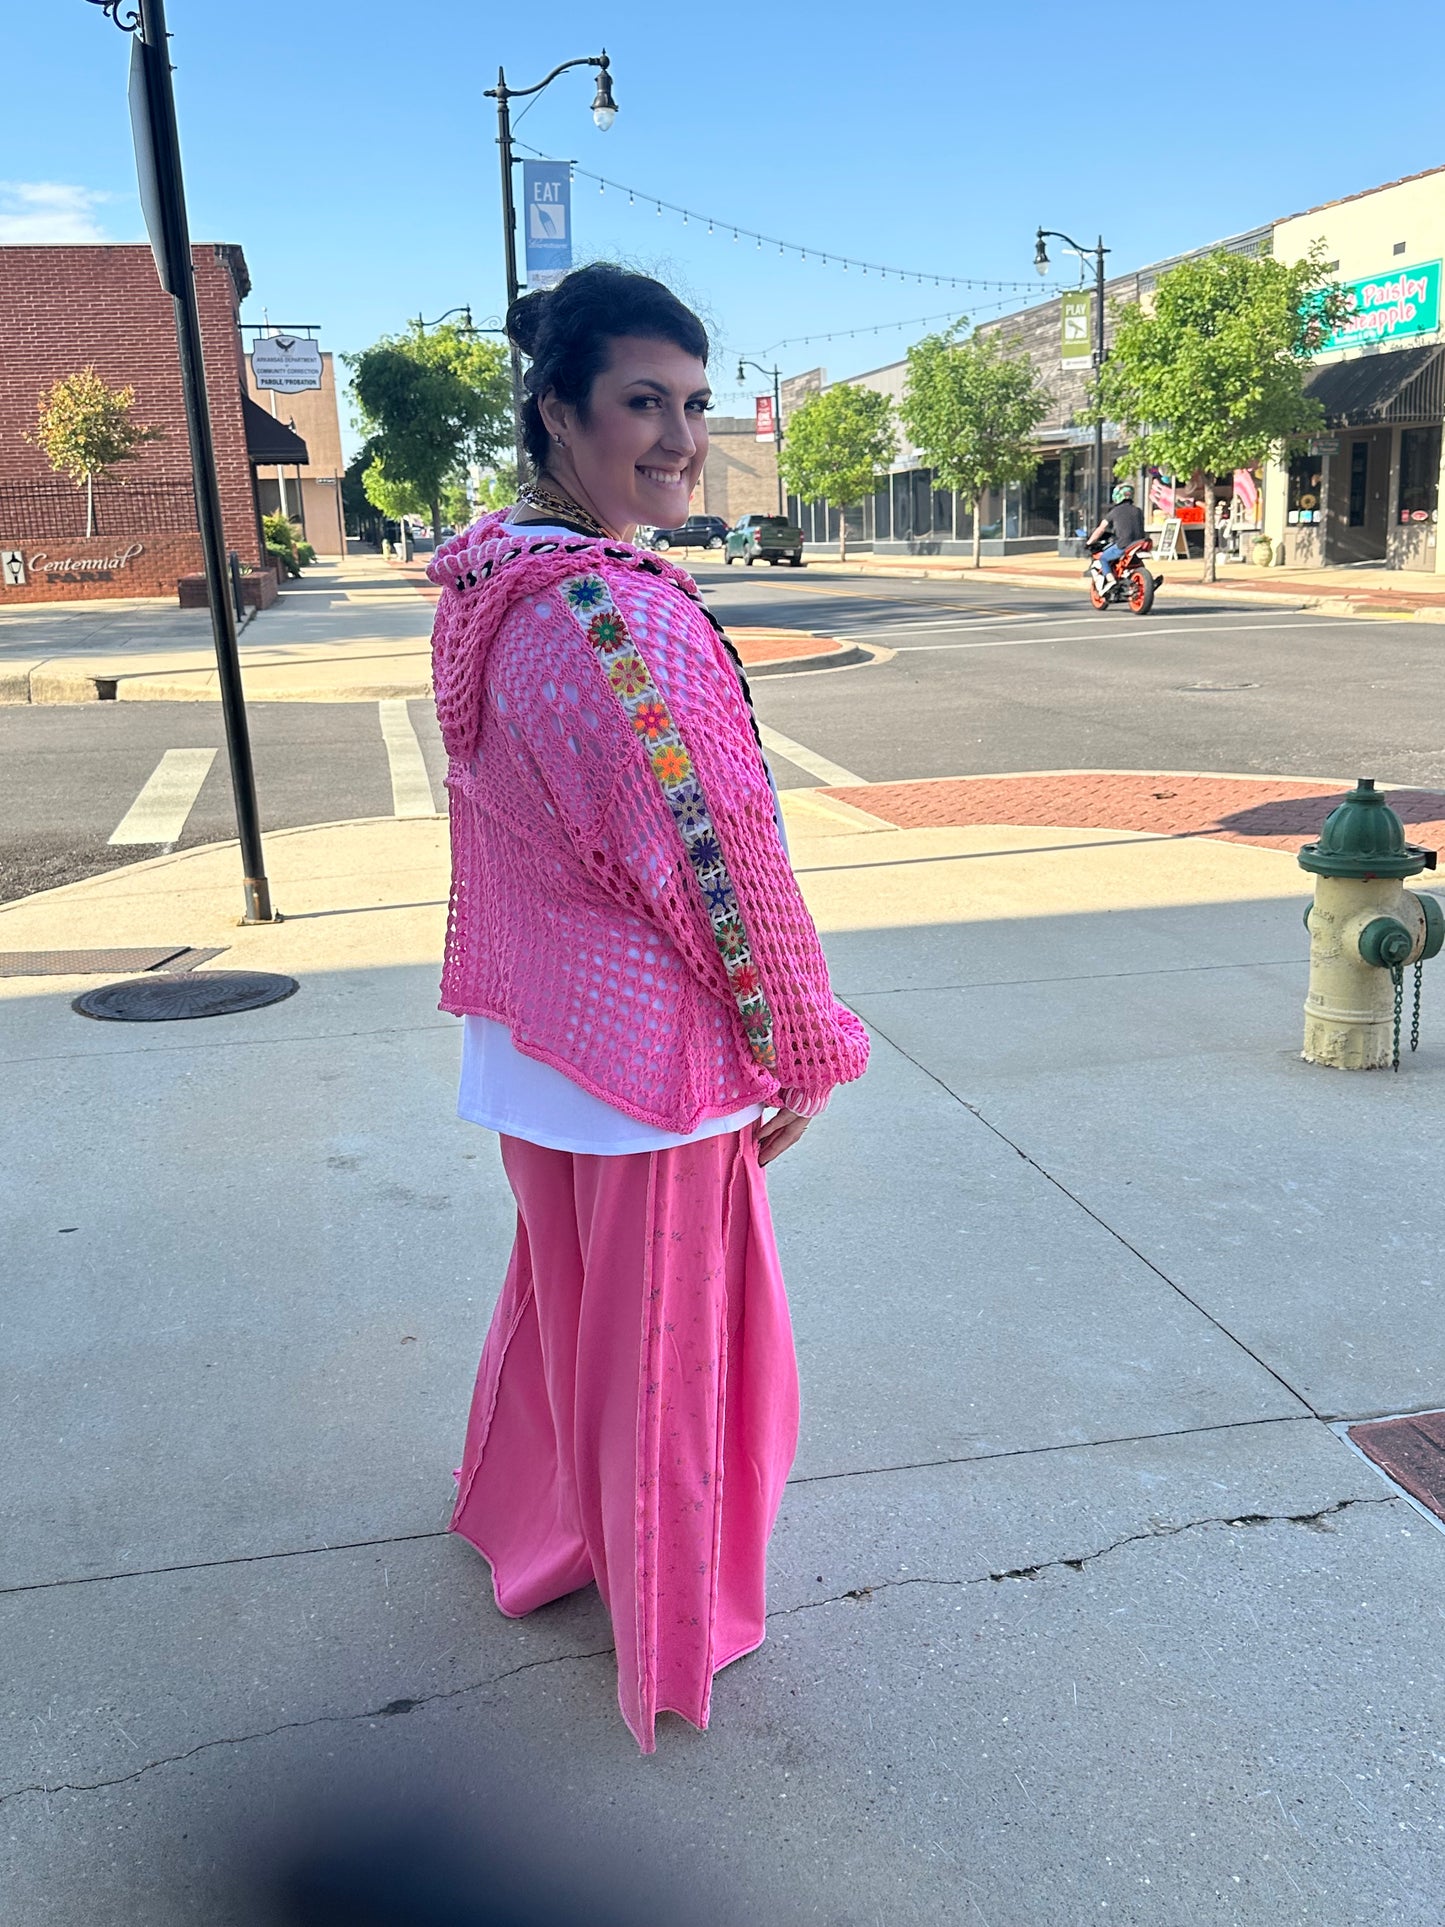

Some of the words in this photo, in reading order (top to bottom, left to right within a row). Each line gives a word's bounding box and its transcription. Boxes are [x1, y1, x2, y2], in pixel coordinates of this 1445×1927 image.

[533, 181, 561, 203] EAT
[1362, 273, 1428, 303] Paisley
[1065, 304, 1087, 316] PLAY
[28, 543, 144, 572] Centennial
[46, 571, 113, 583] PARK
